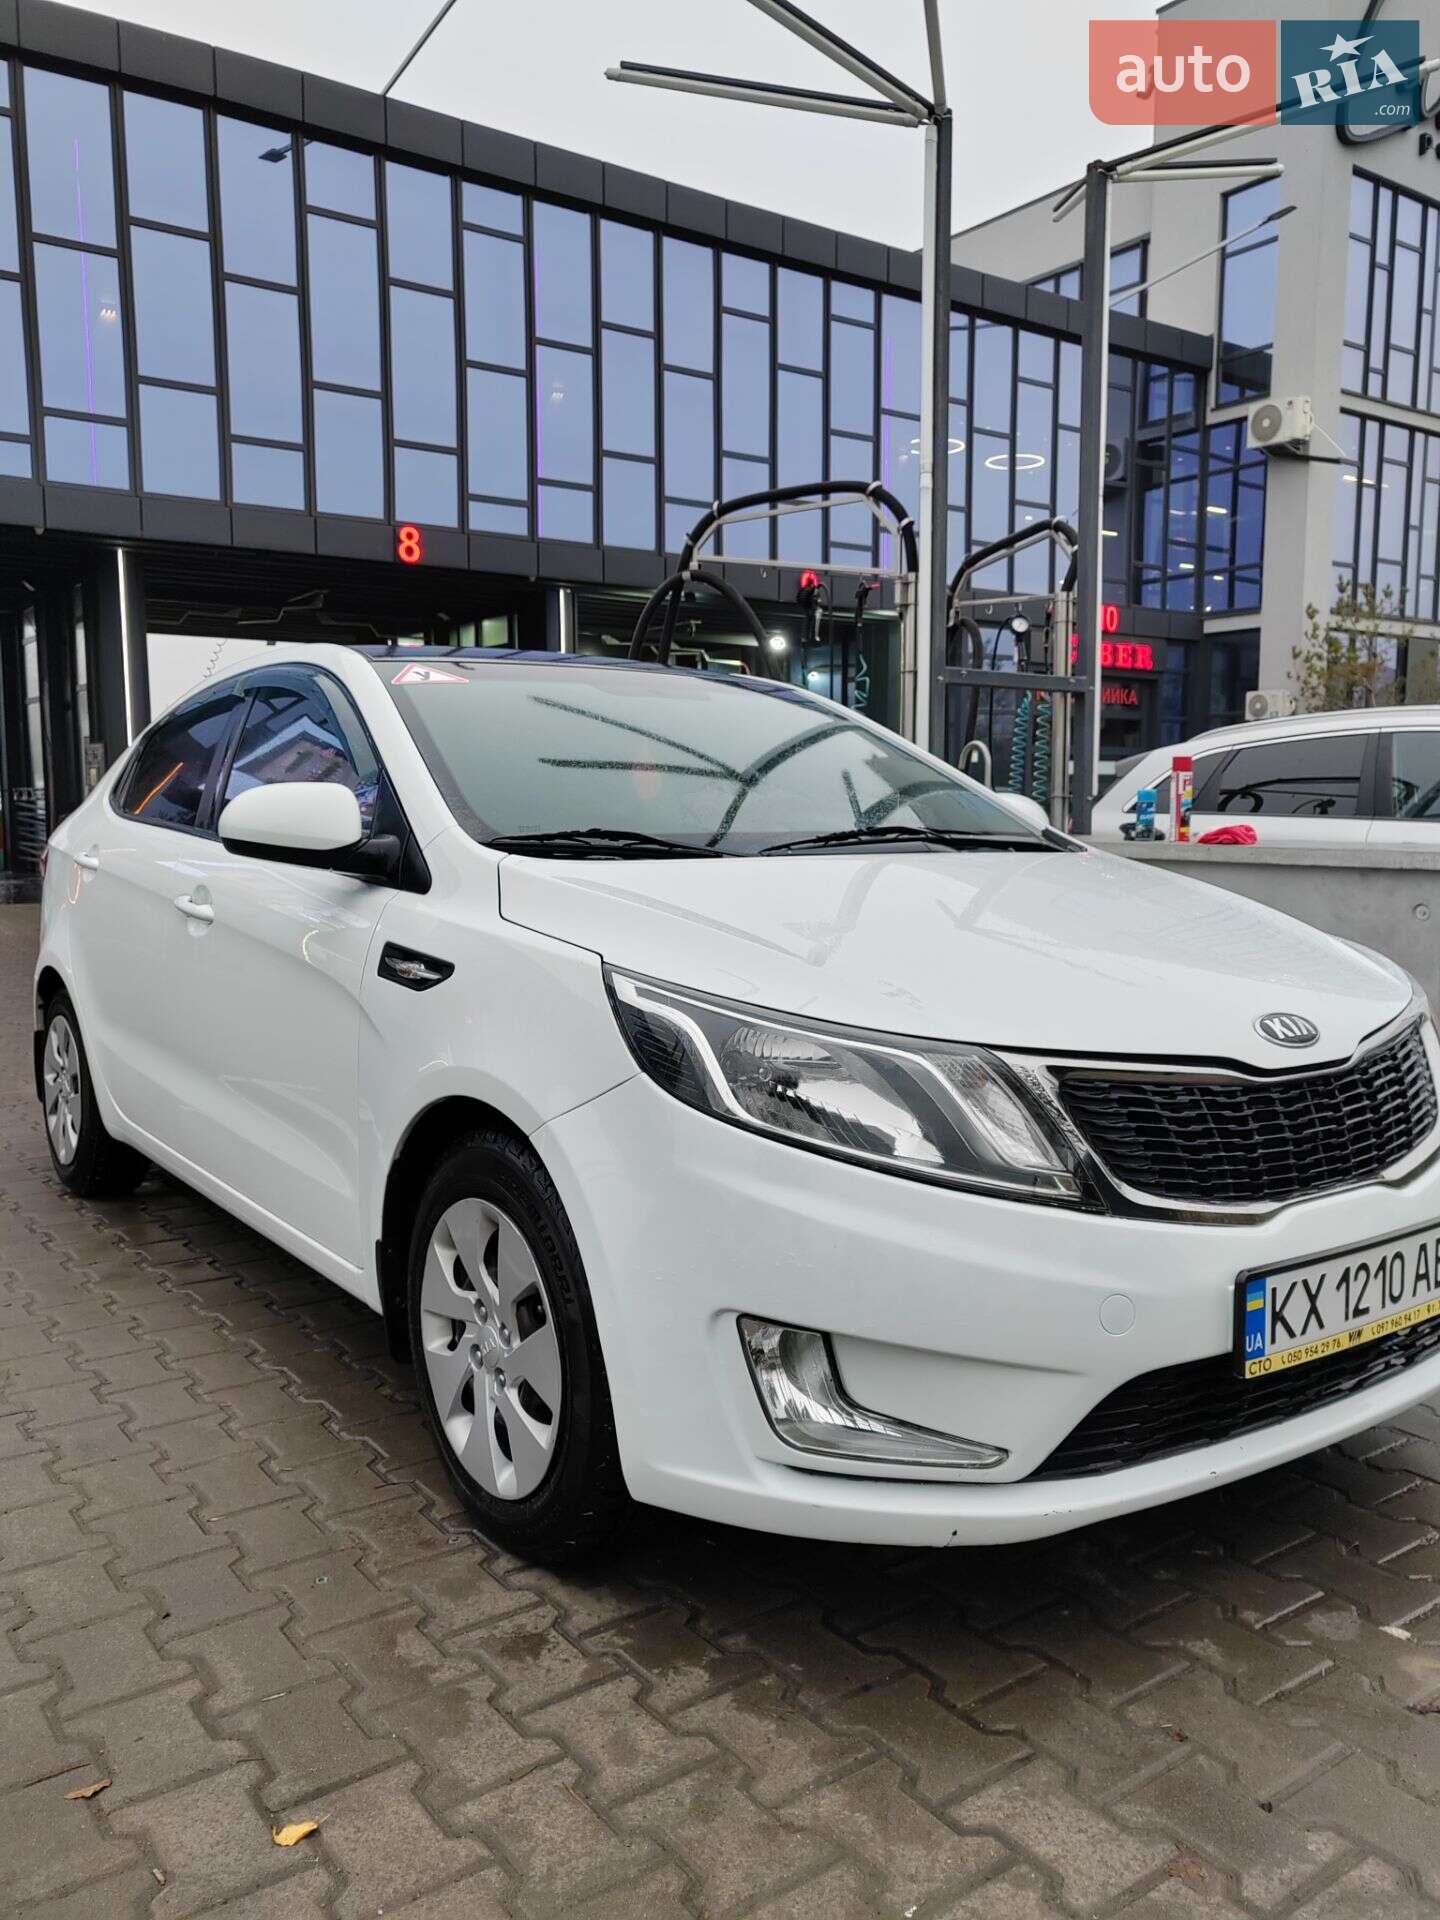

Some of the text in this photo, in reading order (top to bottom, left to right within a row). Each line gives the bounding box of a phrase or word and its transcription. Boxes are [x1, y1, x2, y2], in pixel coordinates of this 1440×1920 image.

[398, 526, 421, 563] 8
[1262, 1016, 1317, 1040] KIA
[1271, 1273, 1327, 1346] KX
[1336, 1251, 1405, 1322] 1210
[1245, 1332, 1263, 1353] UA
